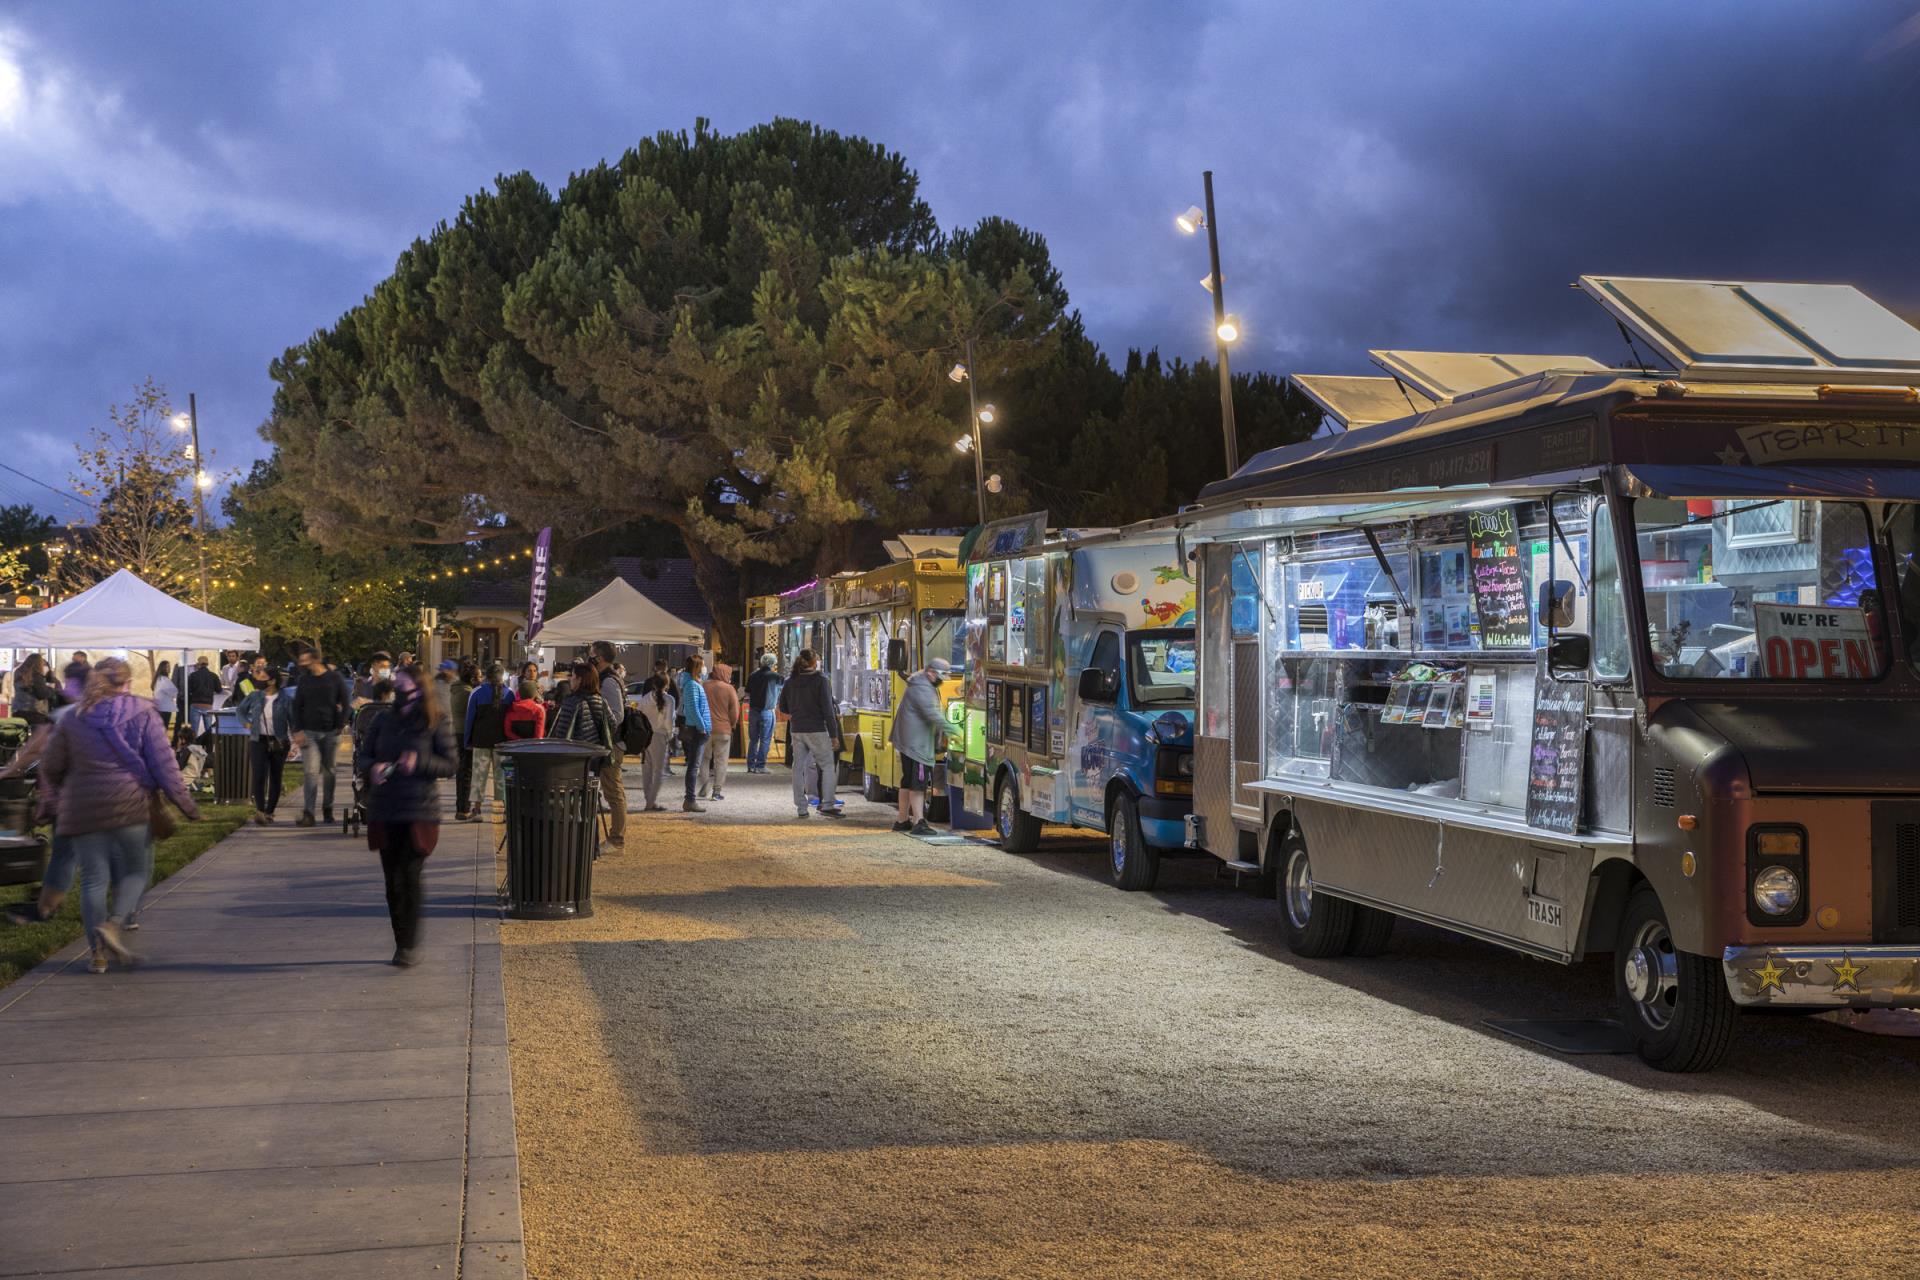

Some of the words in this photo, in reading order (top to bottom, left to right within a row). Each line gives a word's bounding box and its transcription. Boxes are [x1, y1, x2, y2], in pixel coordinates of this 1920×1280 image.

[1747, 423, 1864, 454] TEAR
[1875, 424, 1920, 447] IT
[1480, 515, 1498, 531] FOOD
[532, 546, 547, 623] WINE
[1780, 612, 1839, 627] WE'RE
[1766, 635, 1873, 679] OPEN
[1528, 900, 1561, 926] TRASH
